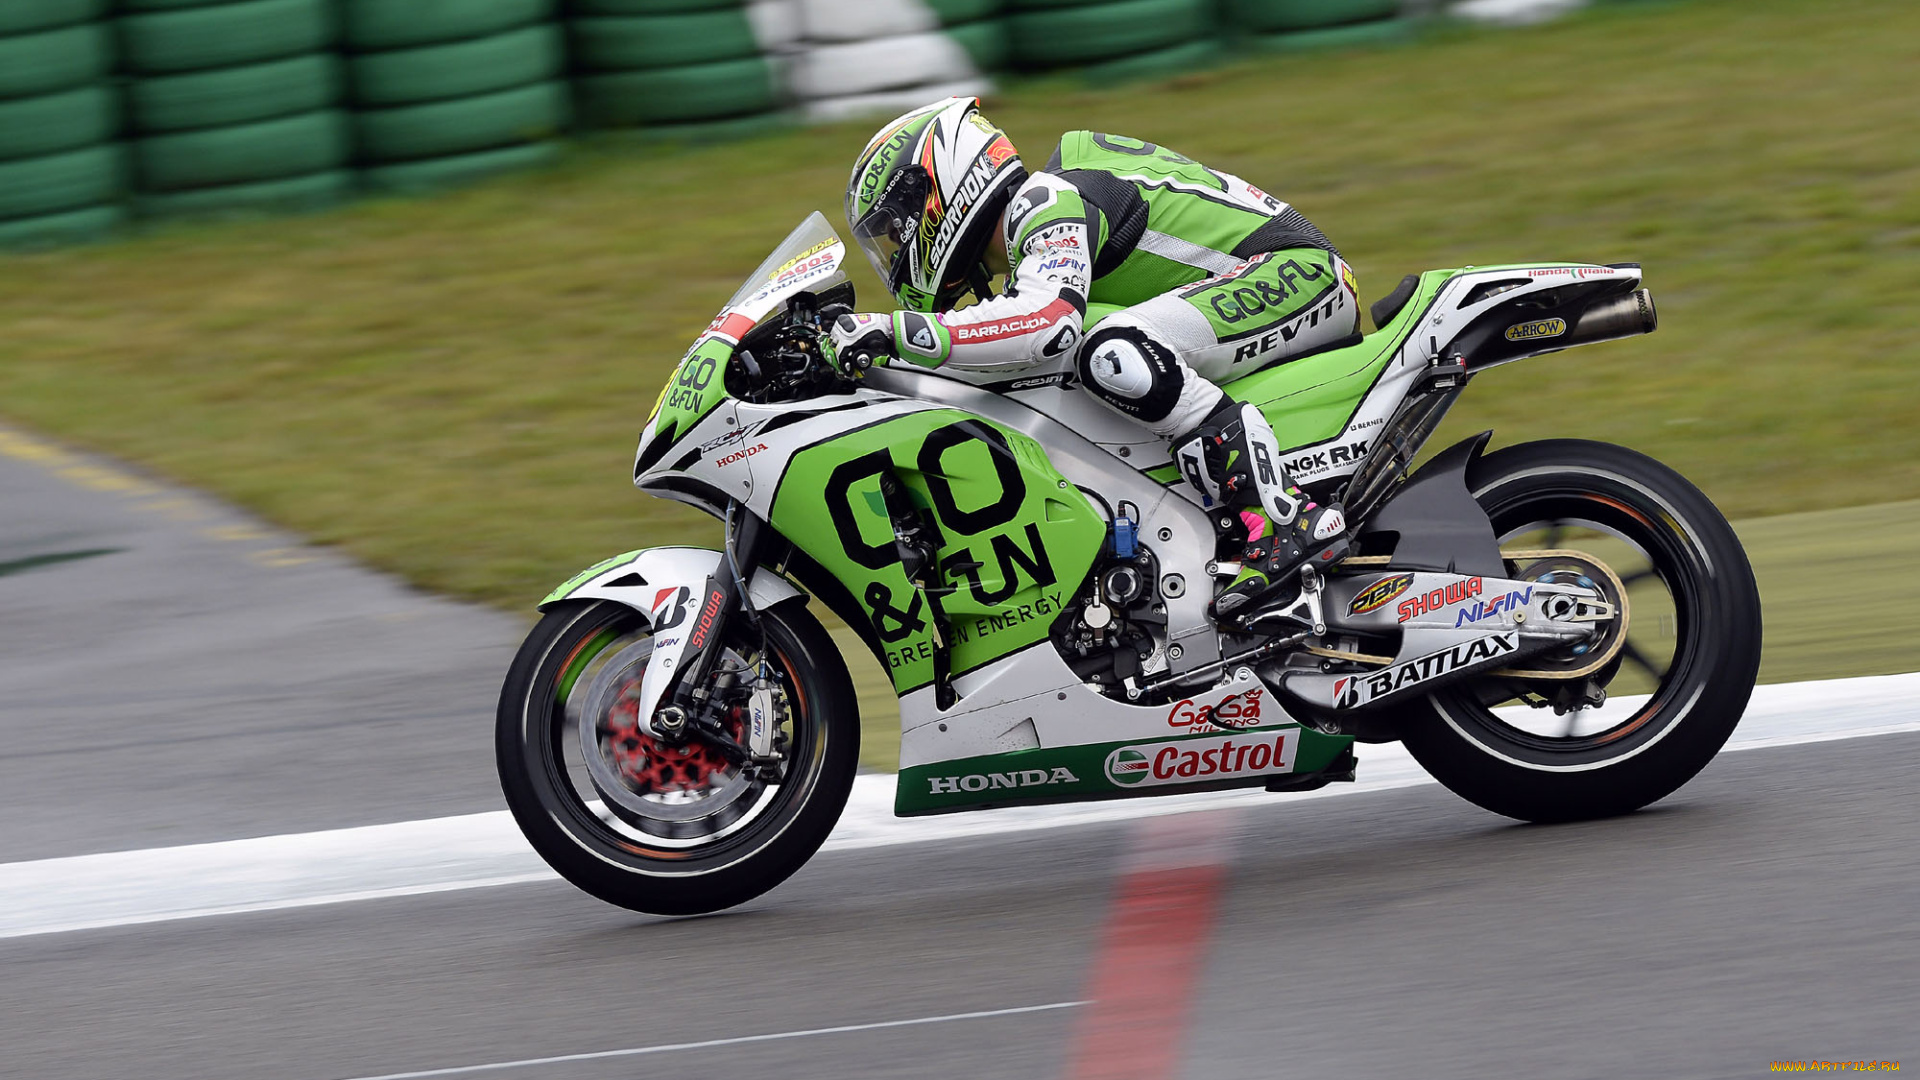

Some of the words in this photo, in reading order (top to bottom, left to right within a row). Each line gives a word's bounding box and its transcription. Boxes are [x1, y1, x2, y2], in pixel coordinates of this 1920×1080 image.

[860, 129, 914, 205] GO&FUN
[930, 156, 993, 270] SCORPION
[1528, 268, 1571, 277] Honda
[1584, 267, 1615, 275] Italia
[958, 316, 1051, 340] BARRACUDA
[1232, 289, 1345, 364] REV'IT!
[1510, 320, 1560, 339] ARROW
[678, 354, 717, 392] GO
[668, 387, 704, 414] &FUN
[1357, 417, 1384, 430] BERNER
[715, 442, 769, 469] HONDA
[1283, 451, 1328, 476] NGK
[1329, 439, 1369, 465] RK
[1290, 470, 1309, 481] PARK
[975, 591, 1062, 638] ENERGY
[1397, 576, 1483, 624] SHOWA
[692, 590, 723, 649] SHOWA
[1367, 631, 1515, 700] BATTLAX
[1152, 735, 1286, 780] Castrol
[927, 766, 1080, 795] HONDA
